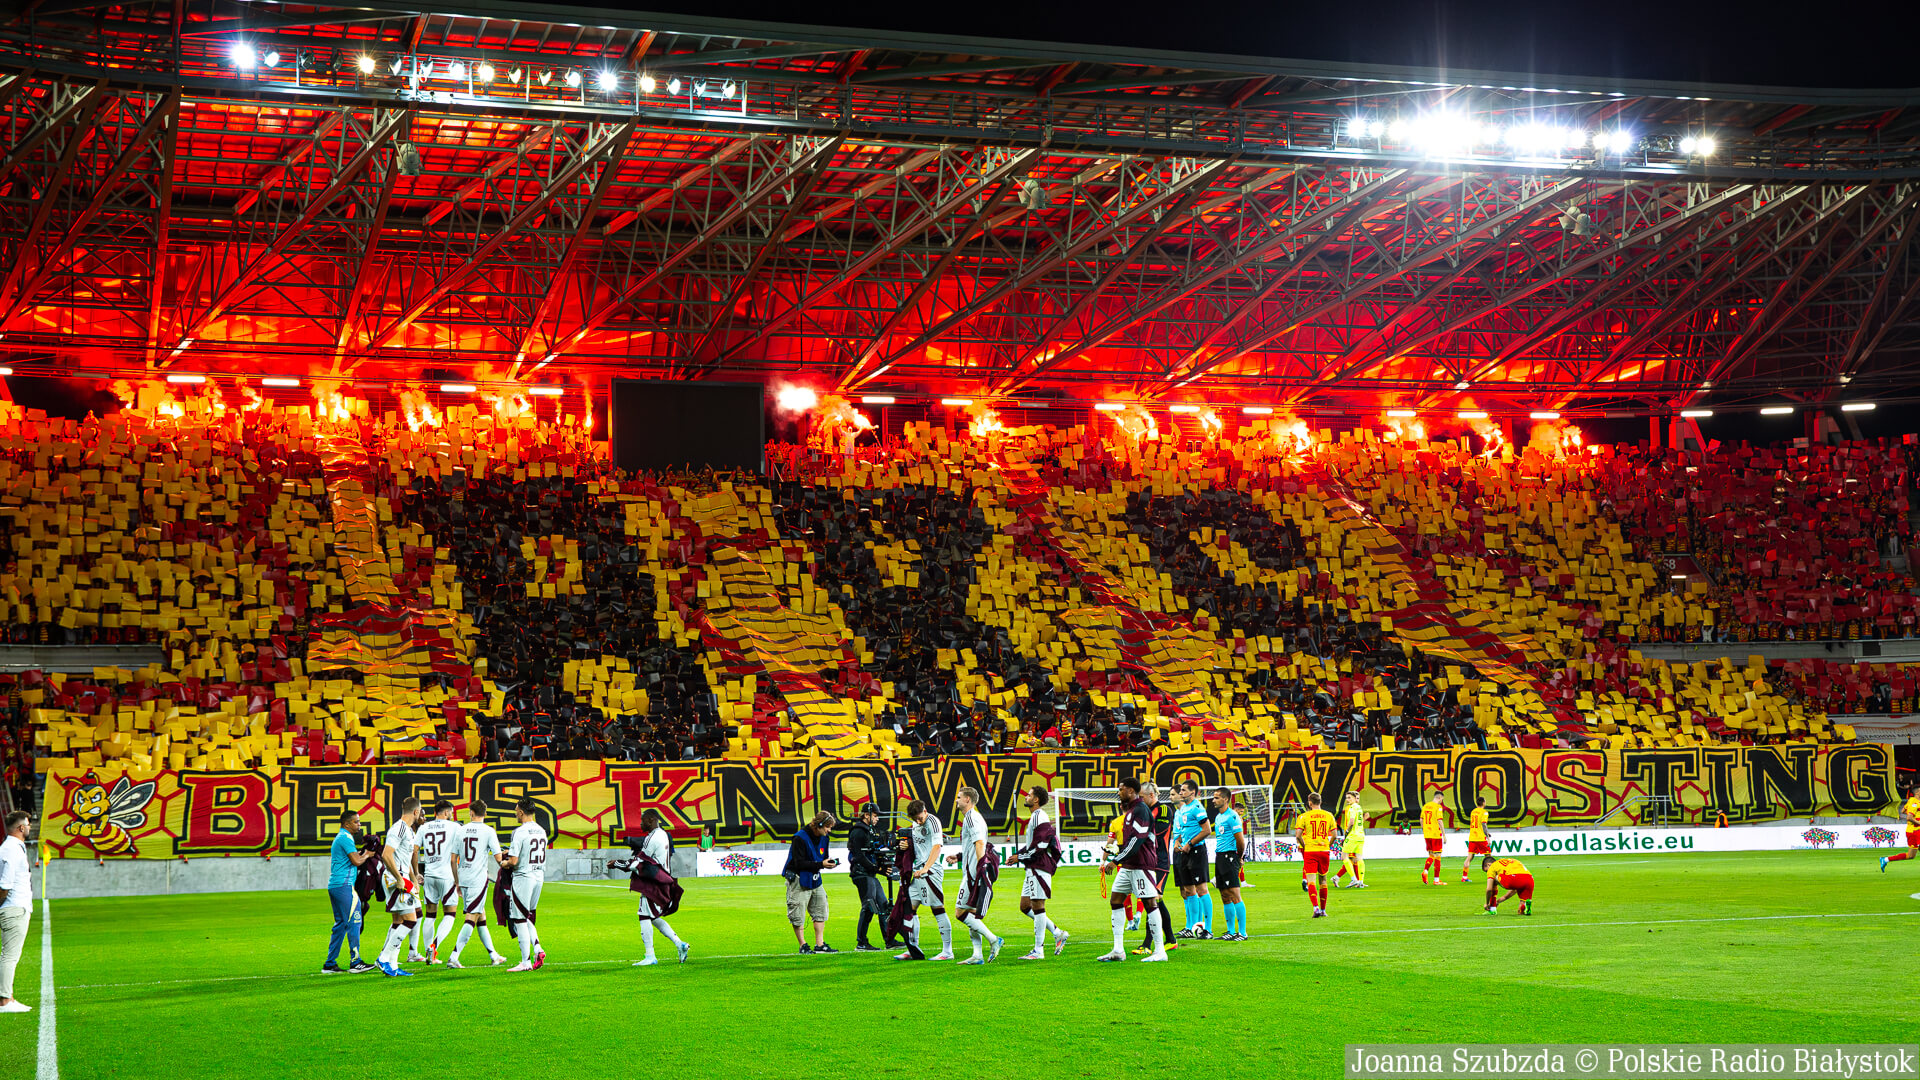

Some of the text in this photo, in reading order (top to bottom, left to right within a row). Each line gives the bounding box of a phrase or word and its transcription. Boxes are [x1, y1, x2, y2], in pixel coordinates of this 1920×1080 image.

[173, 744, 1893, 855] BEES KNOW HOW TO STING
[1309, 820, 1327, 840] 14
[425, 831, 446, 857] 37
[463, 837, 479, 862] 15
[529, 838, 546, 864] 23
[1465, 832, 1693, 857] ww.podlaskie.eu
[1136, 878, 1145, 890] 10
